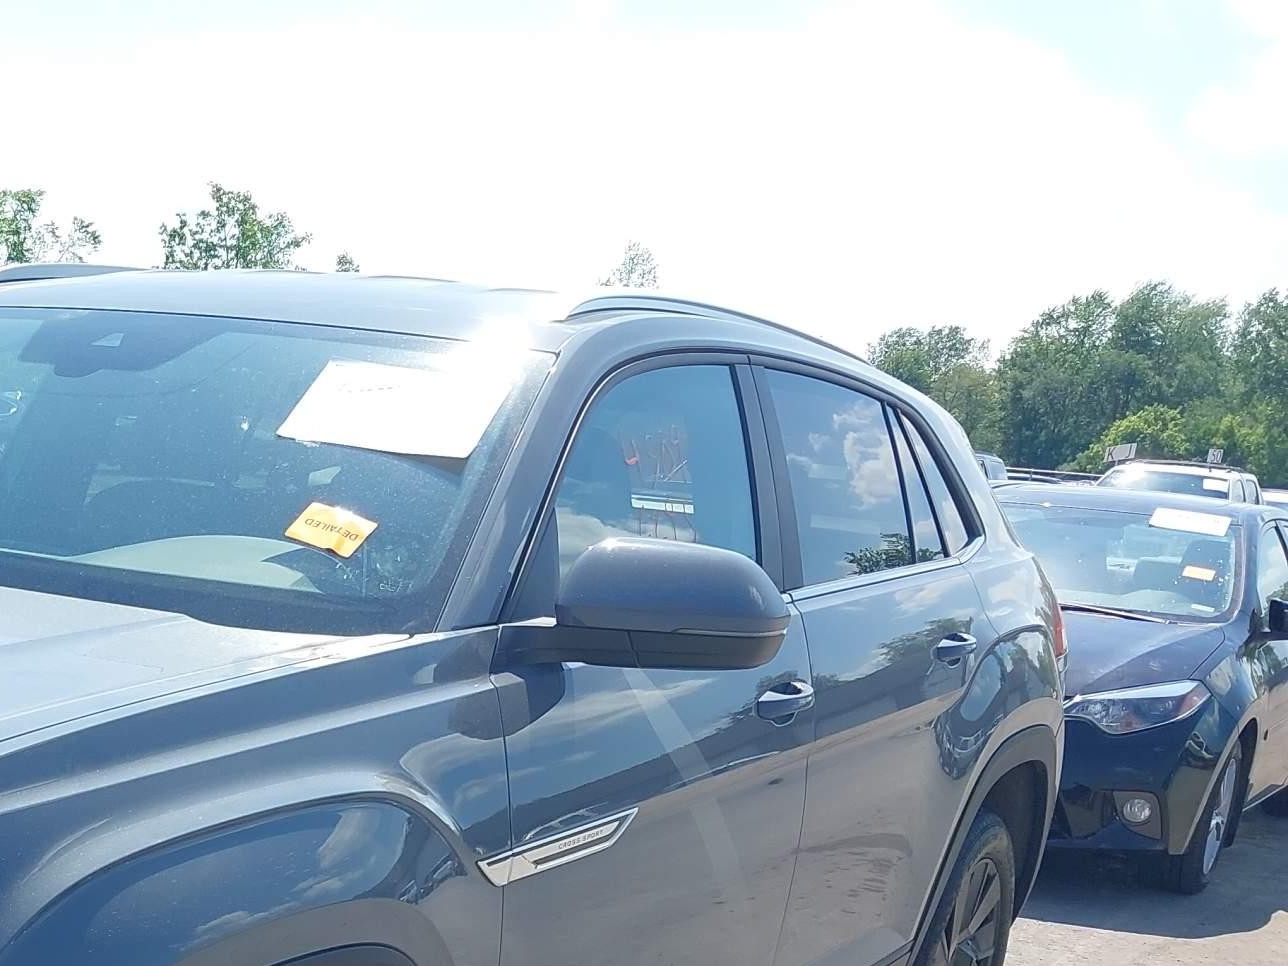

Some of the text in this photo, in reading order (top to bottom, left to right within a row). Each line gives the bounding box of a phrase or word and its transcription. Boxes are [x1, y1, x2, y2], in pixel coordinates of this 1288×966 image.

[305, 518, 360, 541] DETAILED
[558, 830, 603, 850] CROSS SPORT
